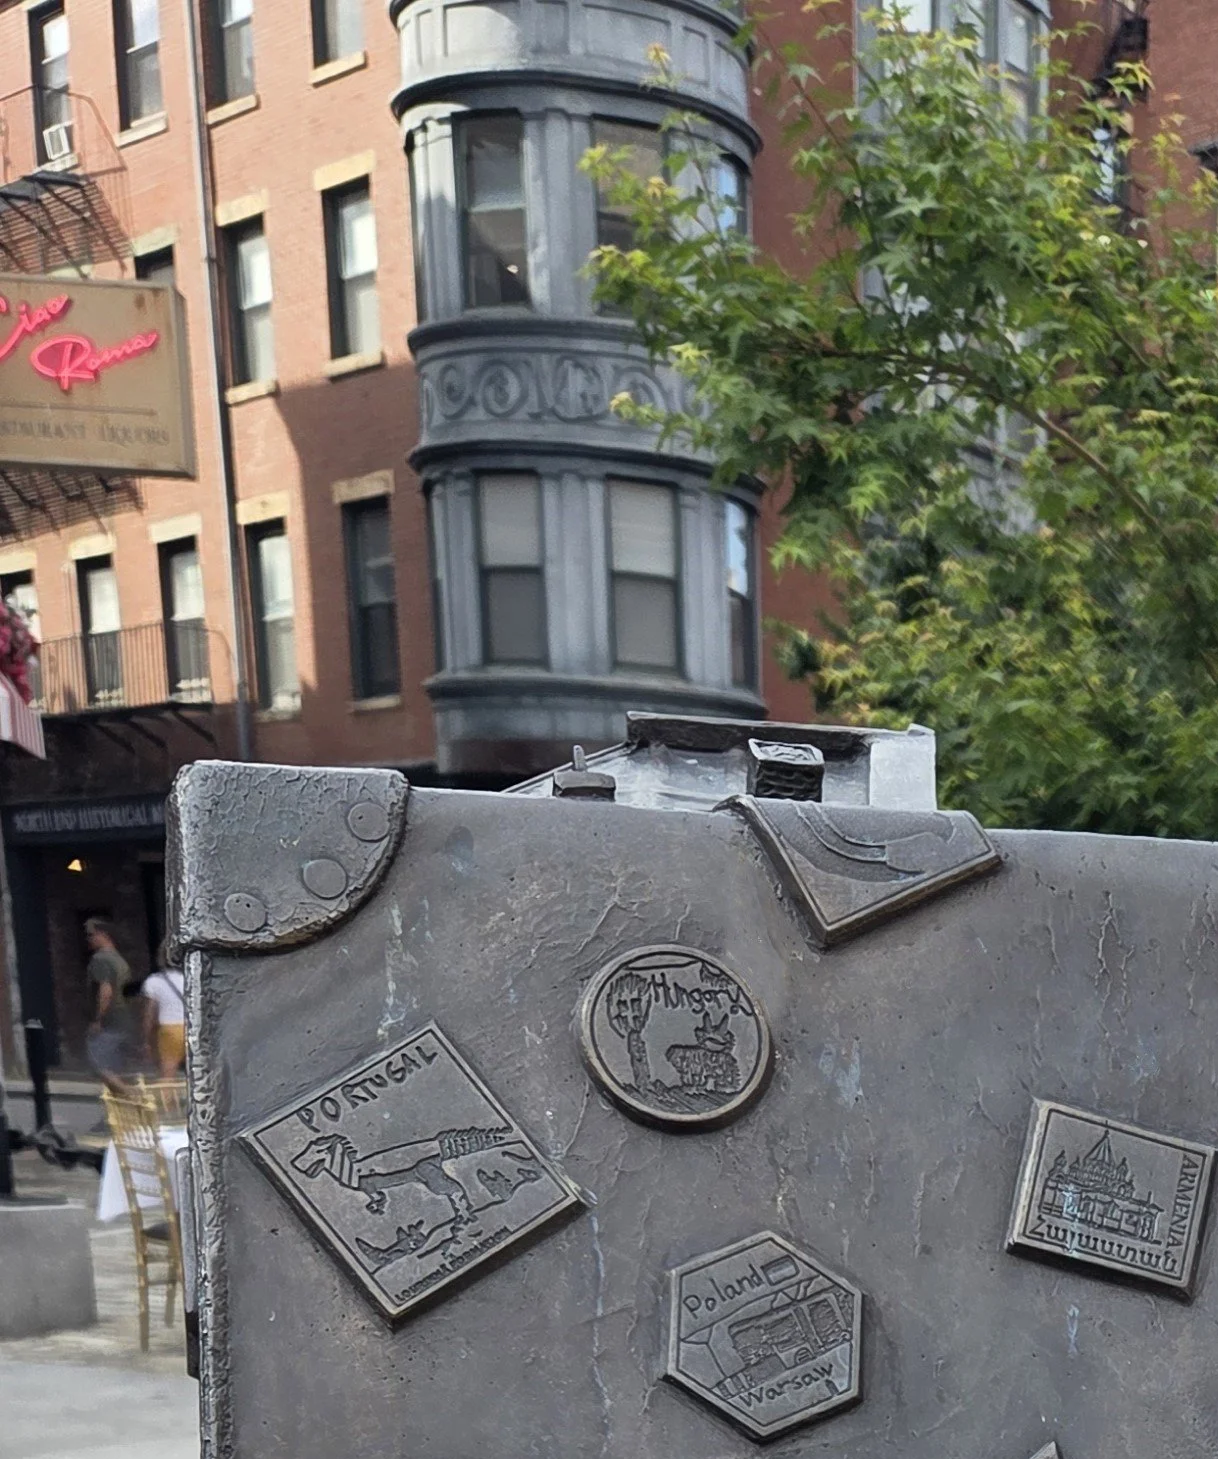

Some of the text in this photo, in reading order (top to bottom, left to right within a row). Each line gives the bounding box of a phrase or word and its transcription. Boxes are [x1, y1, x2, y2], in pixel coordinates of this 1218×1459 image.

[30, 332, 159, 392] Roma
[296, 1044, 438, 1134] PORTUGAL
[1165, 1153, 1200, 1250] ARMENIA
[682, 1263, 765, 1320] Poland
[738, 1362, 835, 1408] Warsaw
